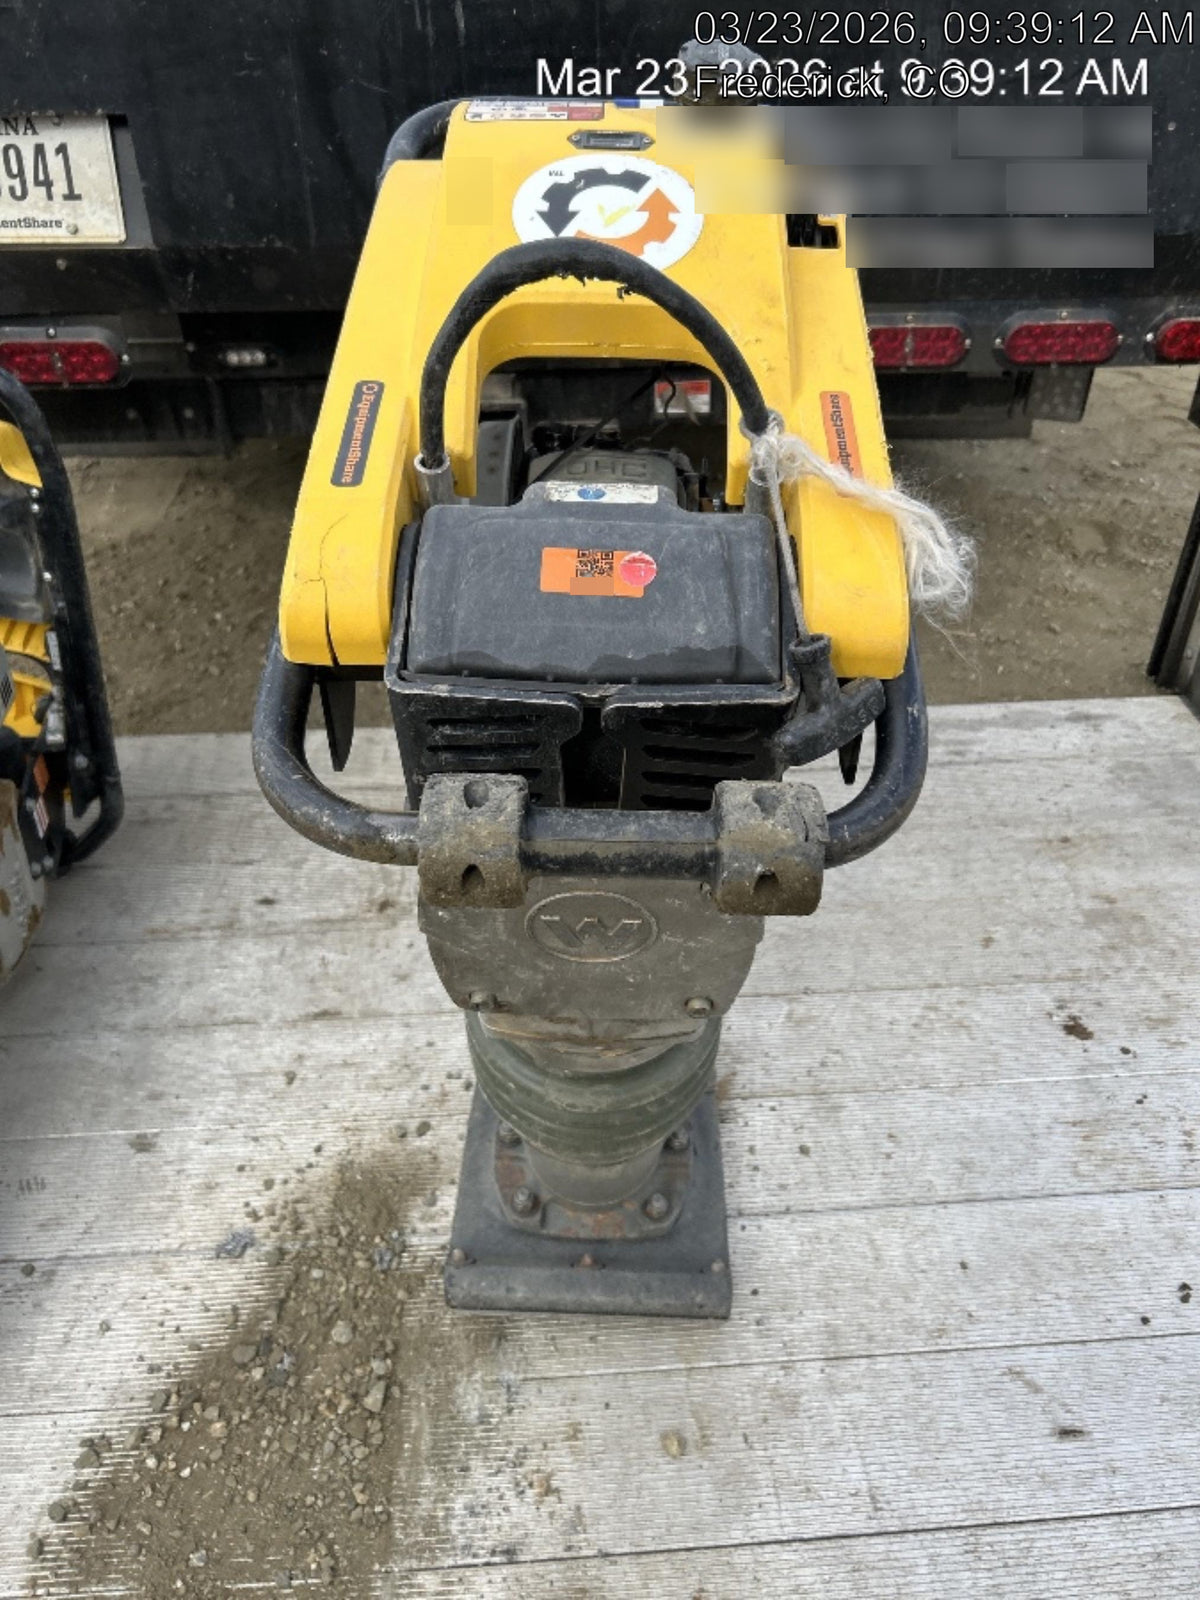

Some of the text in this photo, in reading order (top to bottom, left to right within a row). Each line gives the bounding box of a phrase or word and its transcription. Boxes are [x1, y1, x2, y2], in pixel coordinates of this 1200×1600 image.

[0, 115, 39, 136] NA
[0, 142, 82, 201] 941
[0, 217, 63, 229] entShare
